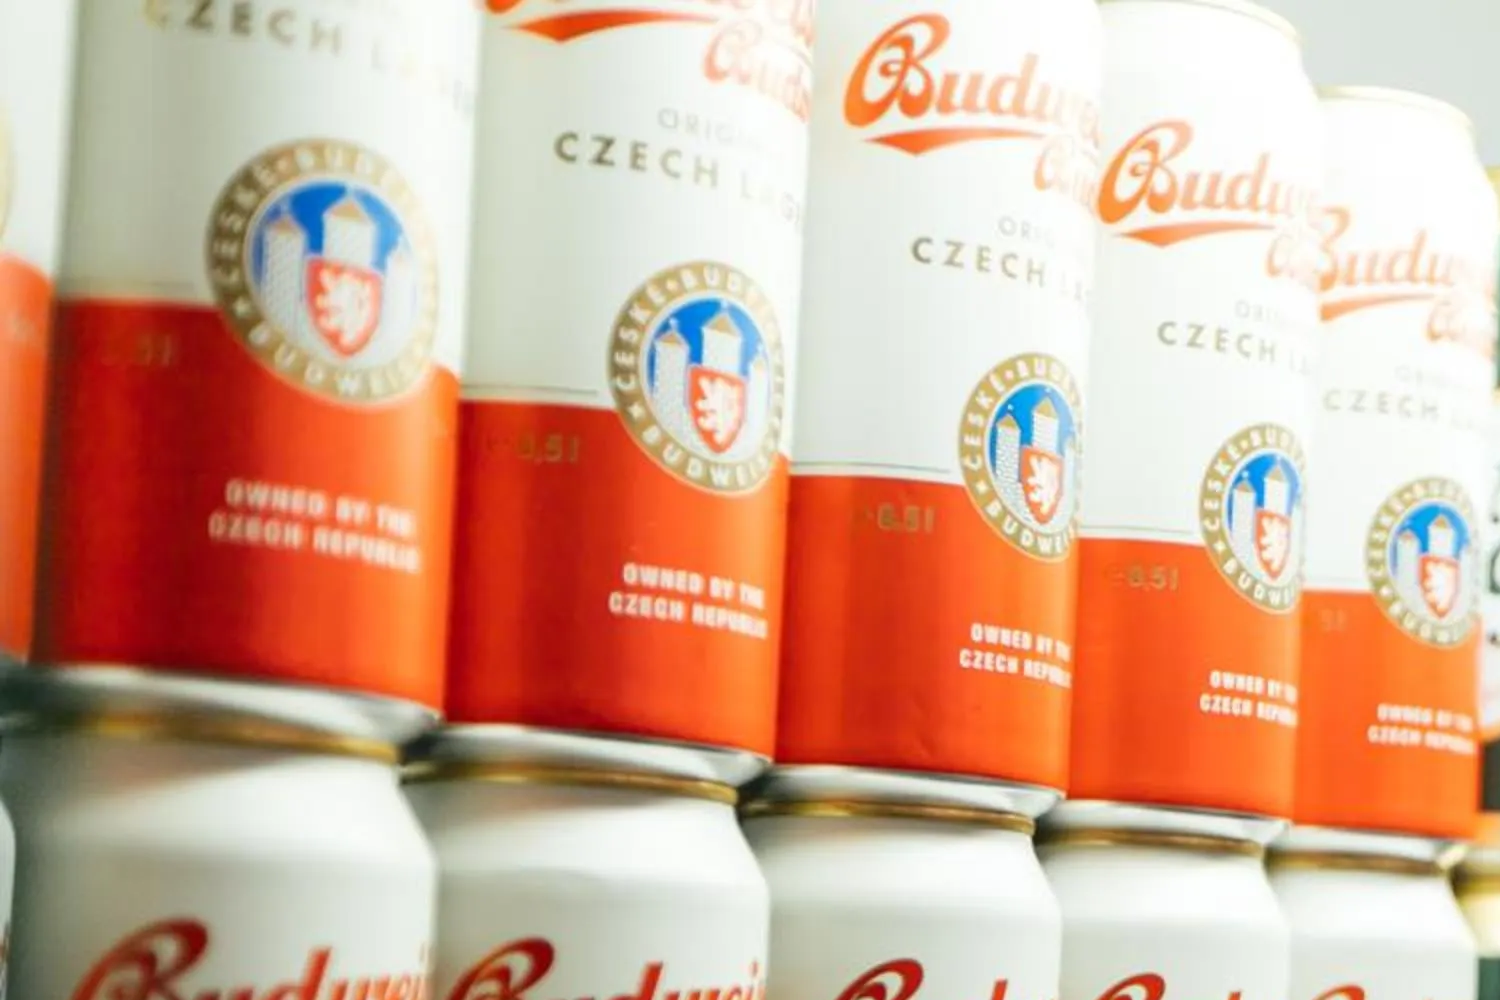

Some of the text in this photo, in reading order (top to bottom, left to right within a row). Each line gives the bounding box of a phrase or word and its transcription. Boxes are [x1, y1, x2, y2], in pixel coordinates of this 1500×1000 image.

[553, 131, 719, 188] CZECH
[910, 236, 1046, 288] CZECH
[1156, 320, 1277, 364] CZECH
[623, 561, 704, 595] OWNED
[709, 575, 734, 599] BY
[608, 592, 684, 623] CZECH
[970, 622, 1032, 652] OWNED
[959, 647, 1018, 674] CZECH
[1209, 669, 1264, 695] OWNED
